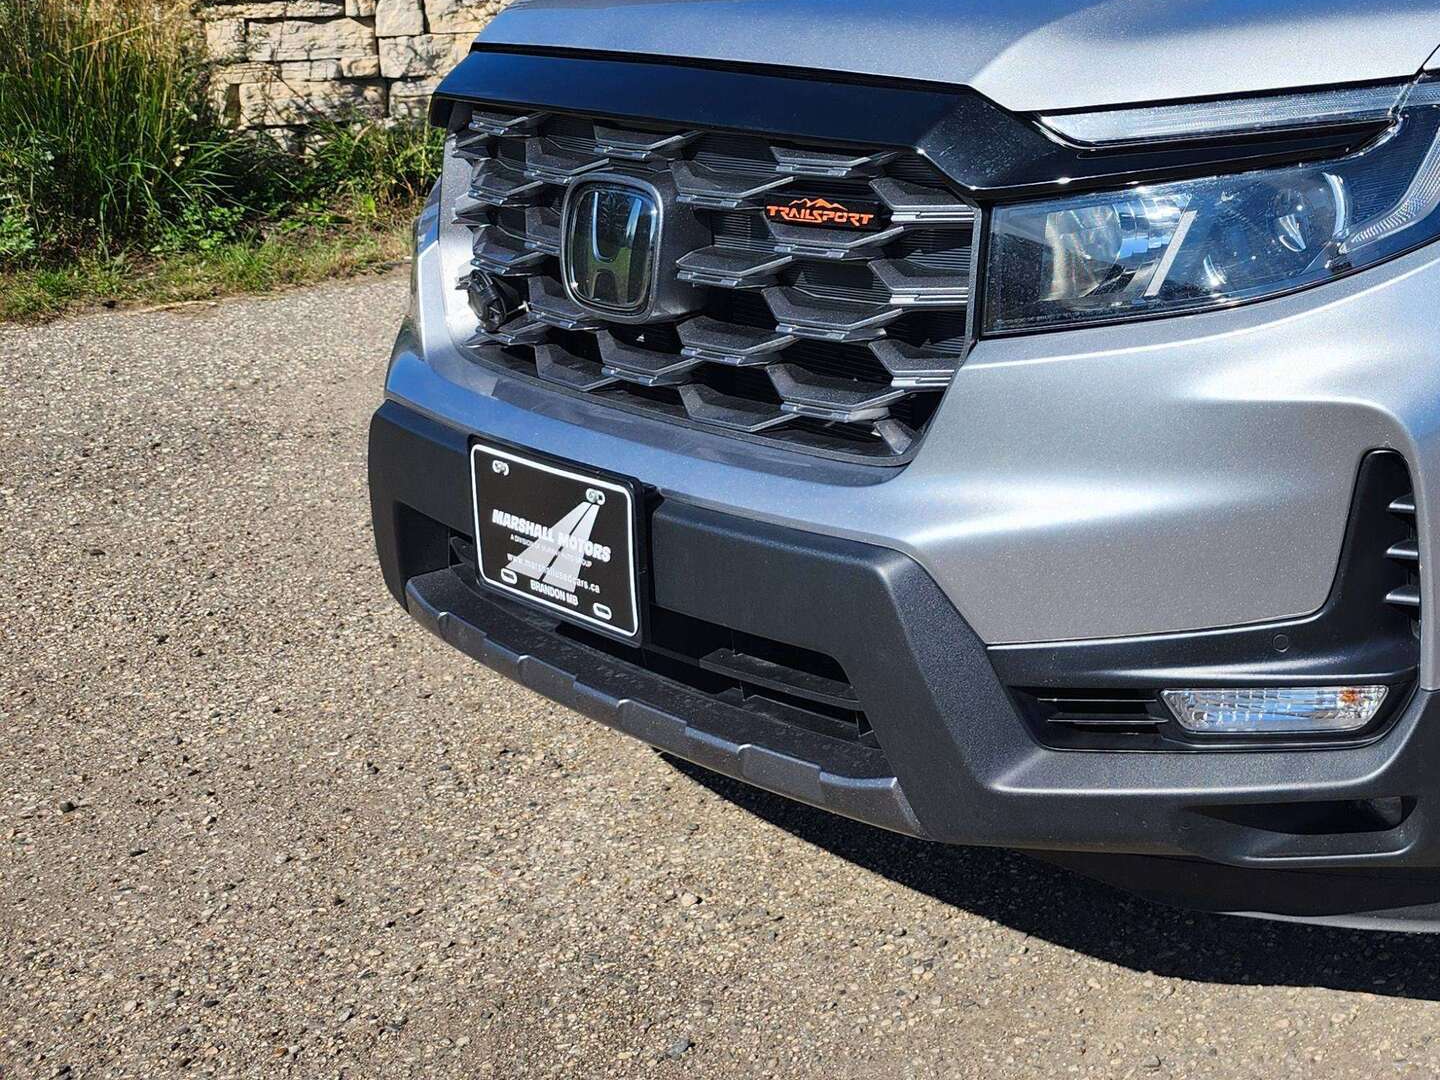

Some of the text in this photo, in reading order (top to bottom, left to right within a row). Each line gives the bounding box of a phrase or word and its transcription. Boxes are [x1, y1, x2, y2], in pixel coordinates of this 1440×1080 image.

[766, 204, 874, 227] TRAILSPORT
[491, 509, 553, 542] MARSHALL
[558, 531, 612, 562] MOTORS
[529, 579, 579, 606] BRANDON MB
